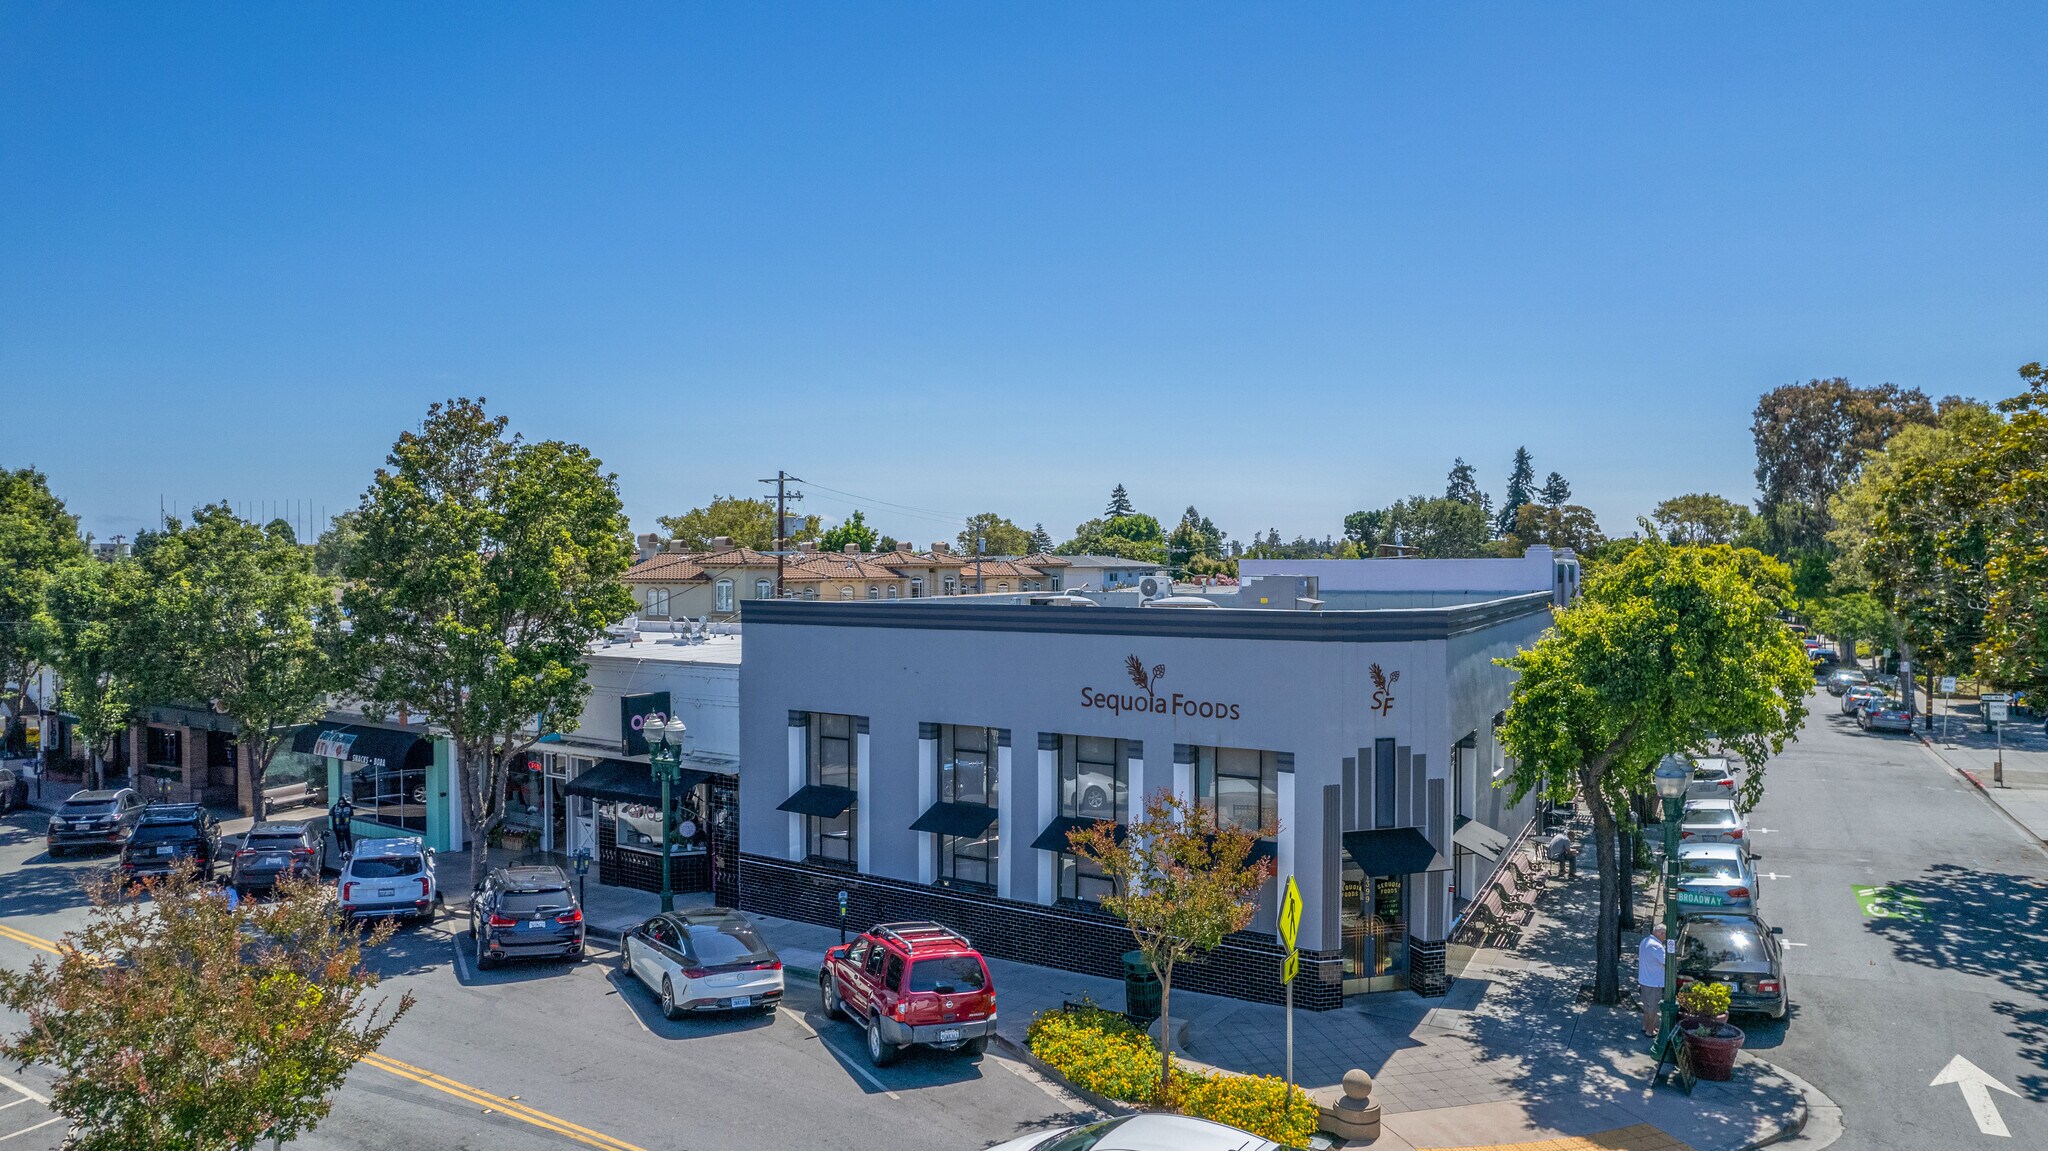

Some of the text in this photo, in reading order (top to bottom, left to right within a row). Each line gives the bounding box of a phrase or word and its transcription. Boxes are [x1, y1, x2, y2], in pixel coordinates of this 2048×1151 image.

[1081, 687, 1167, 716] Sequoia
[352, 754, 370, 765] SNACKS
[1678, 893, 1722, 906] BROADWAY
